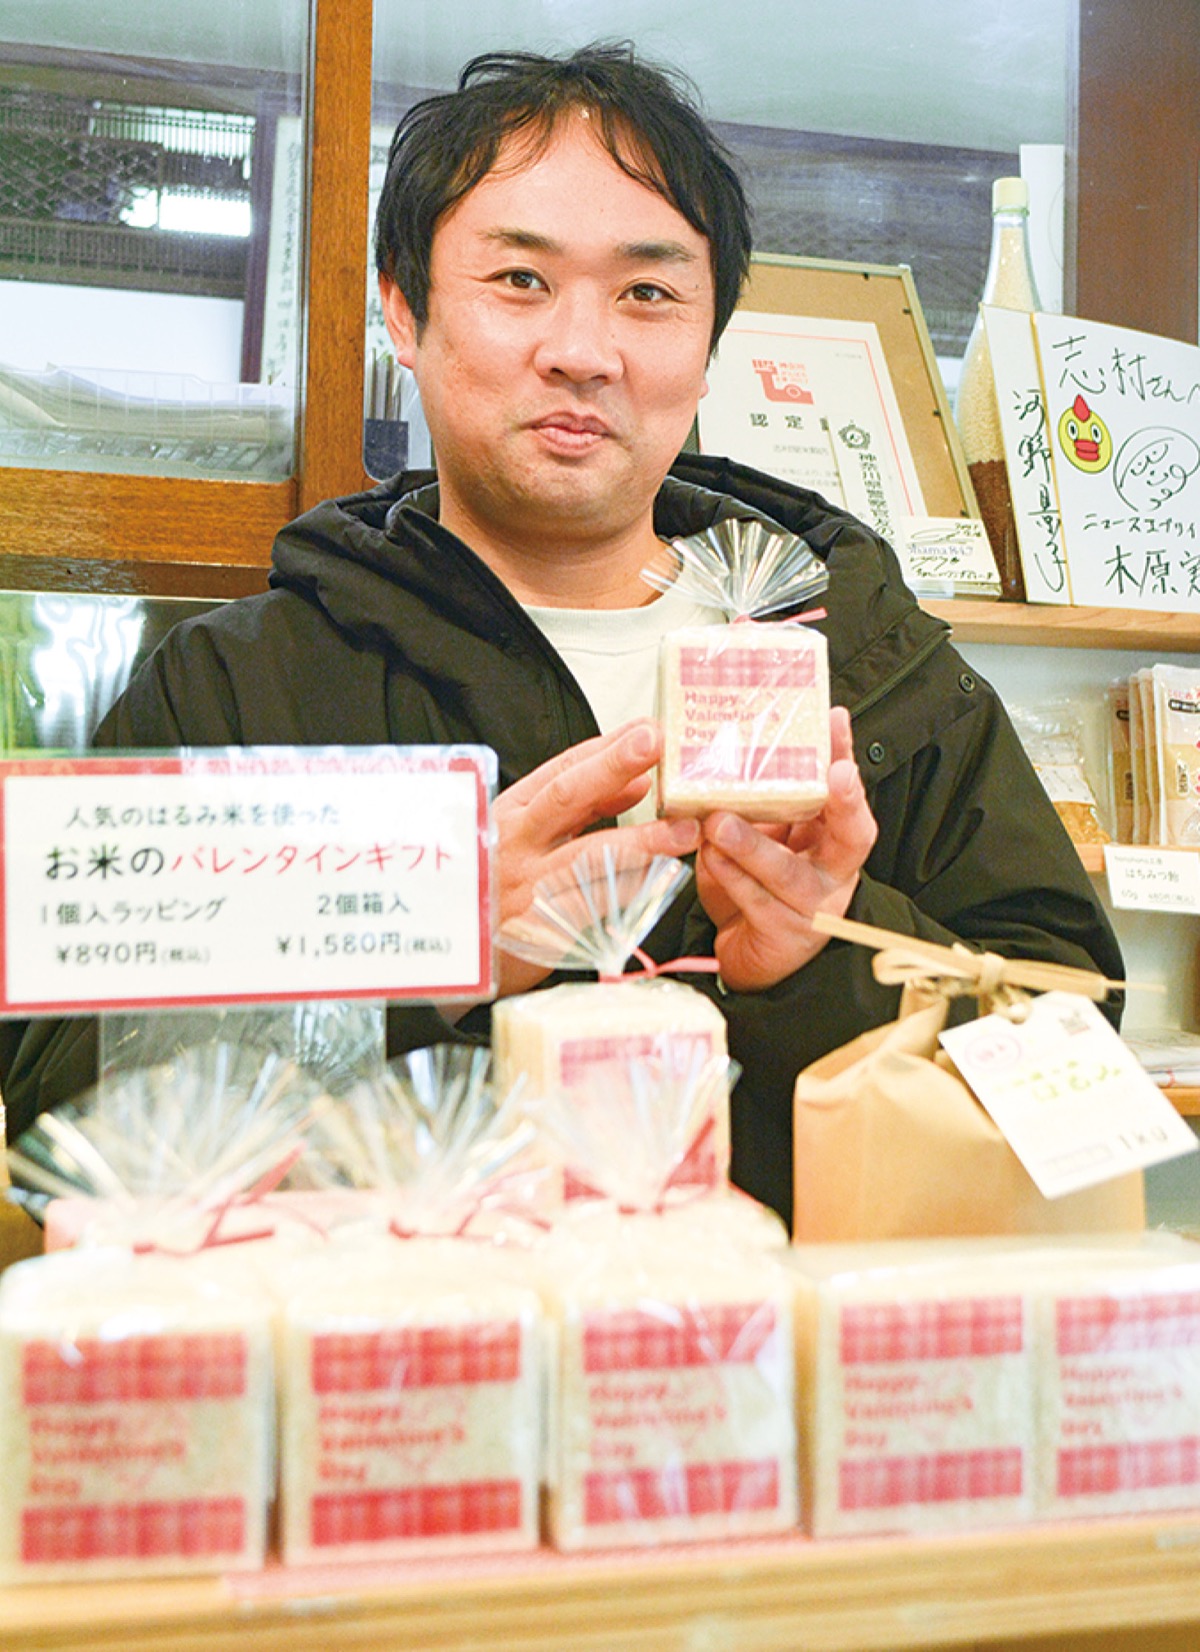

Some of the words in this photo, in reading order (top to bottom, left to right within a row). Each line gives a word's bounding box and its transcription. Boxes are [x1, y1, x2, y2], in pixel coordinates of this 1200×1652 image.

[684, 691, 739, 708] Happy
[684, 726, 718, 742] Day
[65, 804, 340, 829] 人気のはるみ米を使った
[45, 842, 453, 880] お米のバレンタインギフト
[40, 896, 228, 925] 1個入ラッピング
[317, 892, 411, 915] 2個箱入
